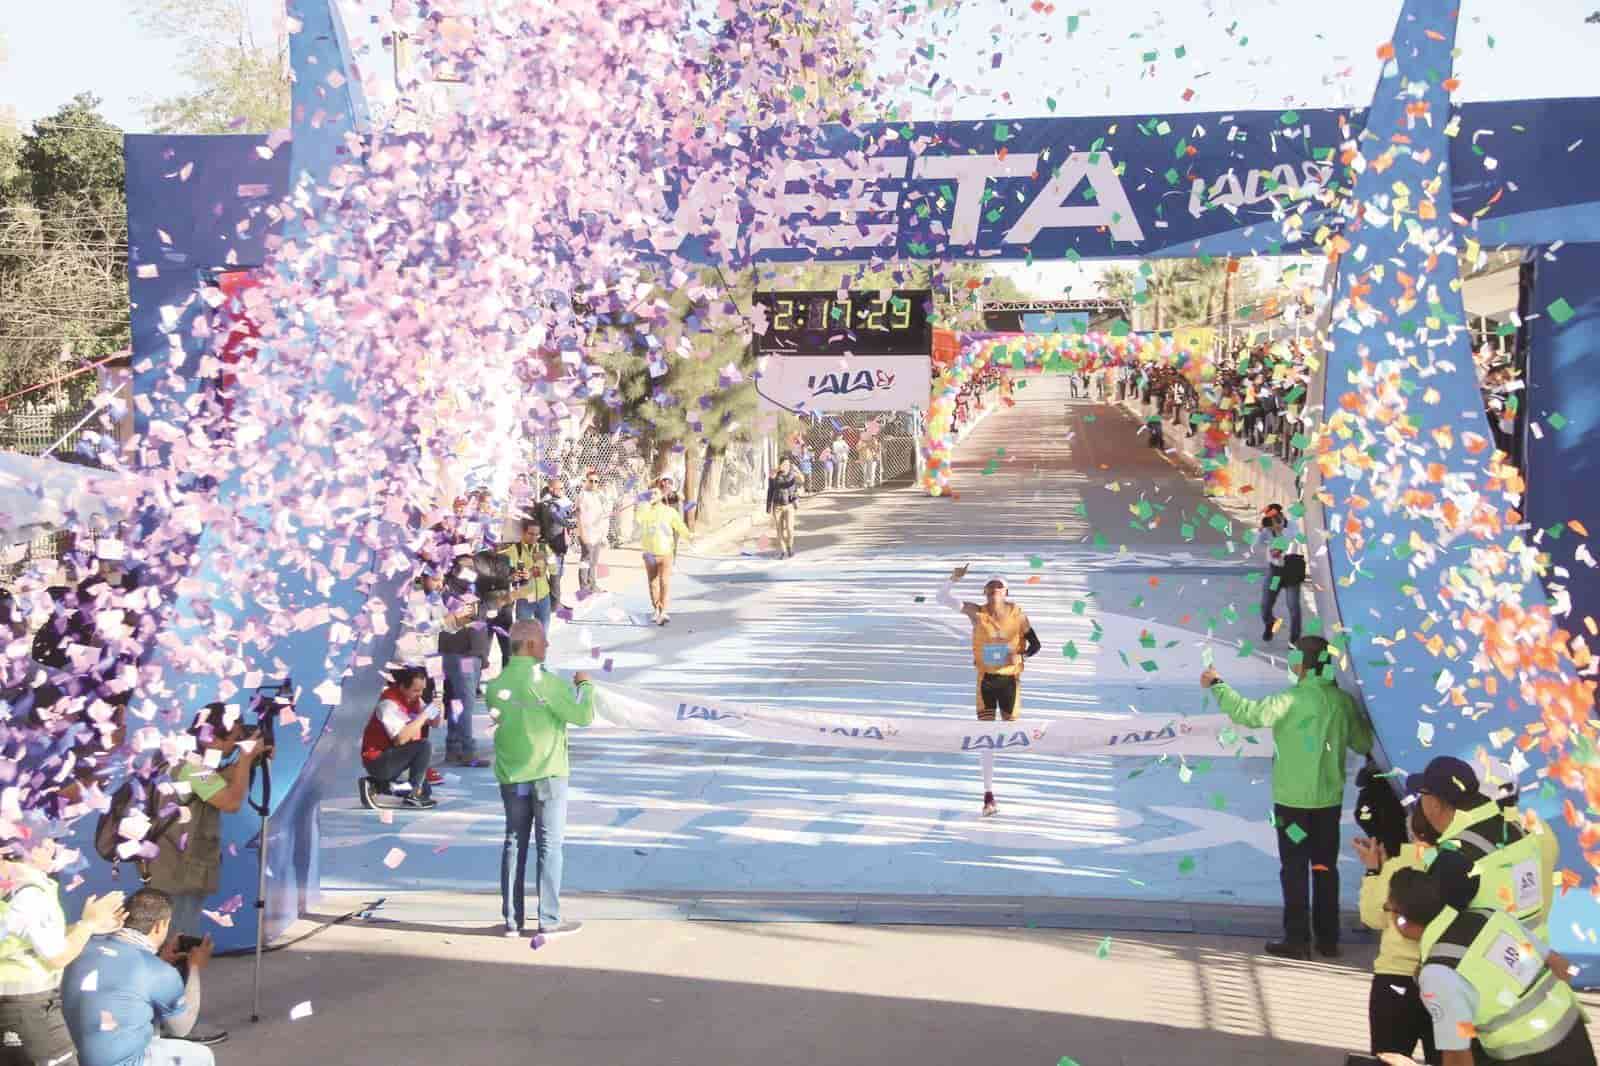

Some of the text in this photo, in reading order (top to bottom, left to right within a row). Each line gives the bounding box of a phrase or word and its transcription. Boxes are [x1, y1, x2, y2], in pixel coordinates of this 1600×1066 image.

[774, 299, 911, 331] 2:17:29
[808, 370, 874, 397] LALA
[961, 730, 1030, 750] LALA
